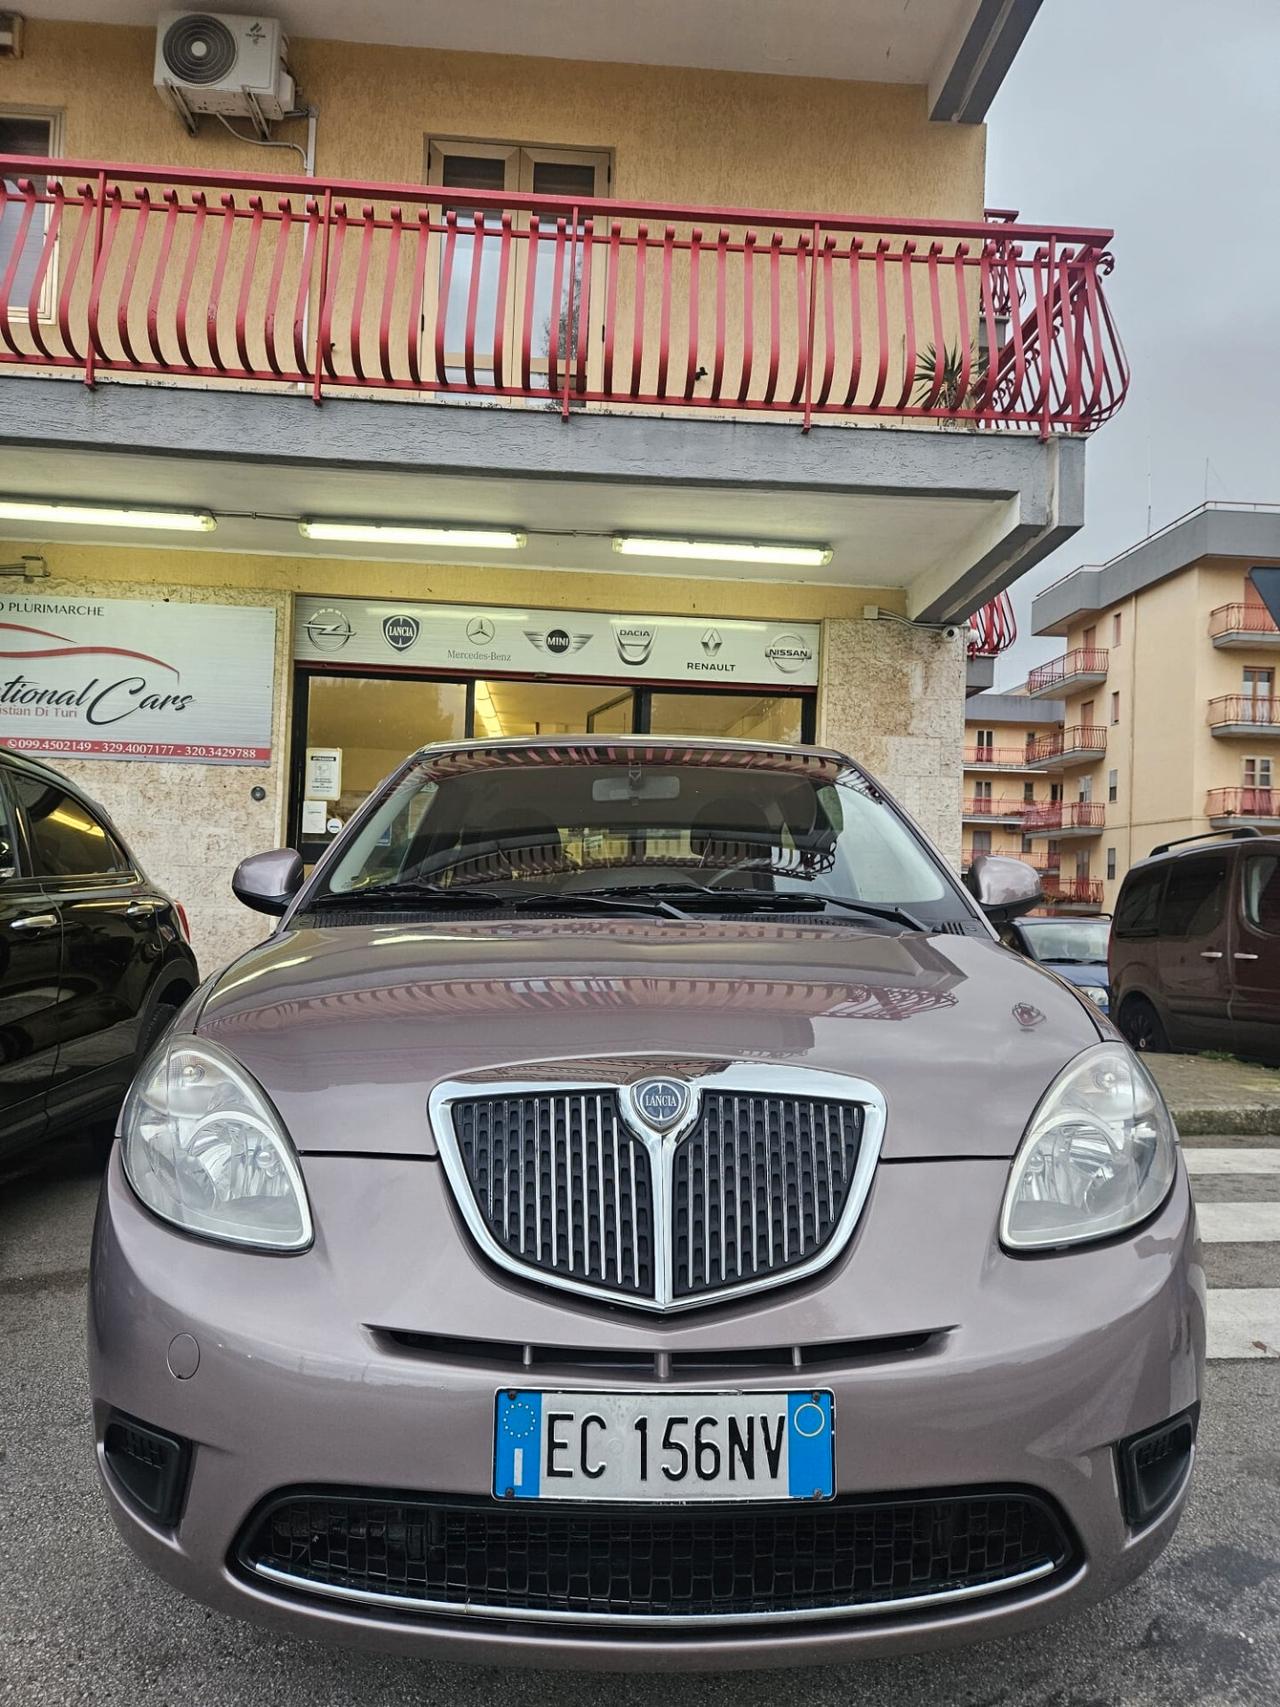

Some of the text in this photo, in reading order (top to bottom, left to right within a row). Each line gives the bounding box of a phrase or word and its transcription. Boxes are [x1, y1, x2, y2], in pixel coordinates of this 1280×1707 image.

[8, 601, 105, 616] PLURIMARCHE
[388, 625, 414, 637] LANCIA
[619, 629, 651, 637] DACIA
[547, 636, 569, 647] MINI
[447, 649, 512, 662] Mercedes-Benz
[769, 648, 808, 657] NISSAN
[686, 662, 736, 672] RENAULT
[86, 676, 197, 725] Cars
[35, 706, 49, 717] Di
[52, 708, 78, 718] Turi
[18, 739, 92, 752] 099.4502149
[102, 742, 174, 755] 329.4007177
[185, 746, 256, 758] 320.3429788
[645, 1095, 677, 1107] LANCIA
[546, 1412, 786, 1481] EC 156NV
